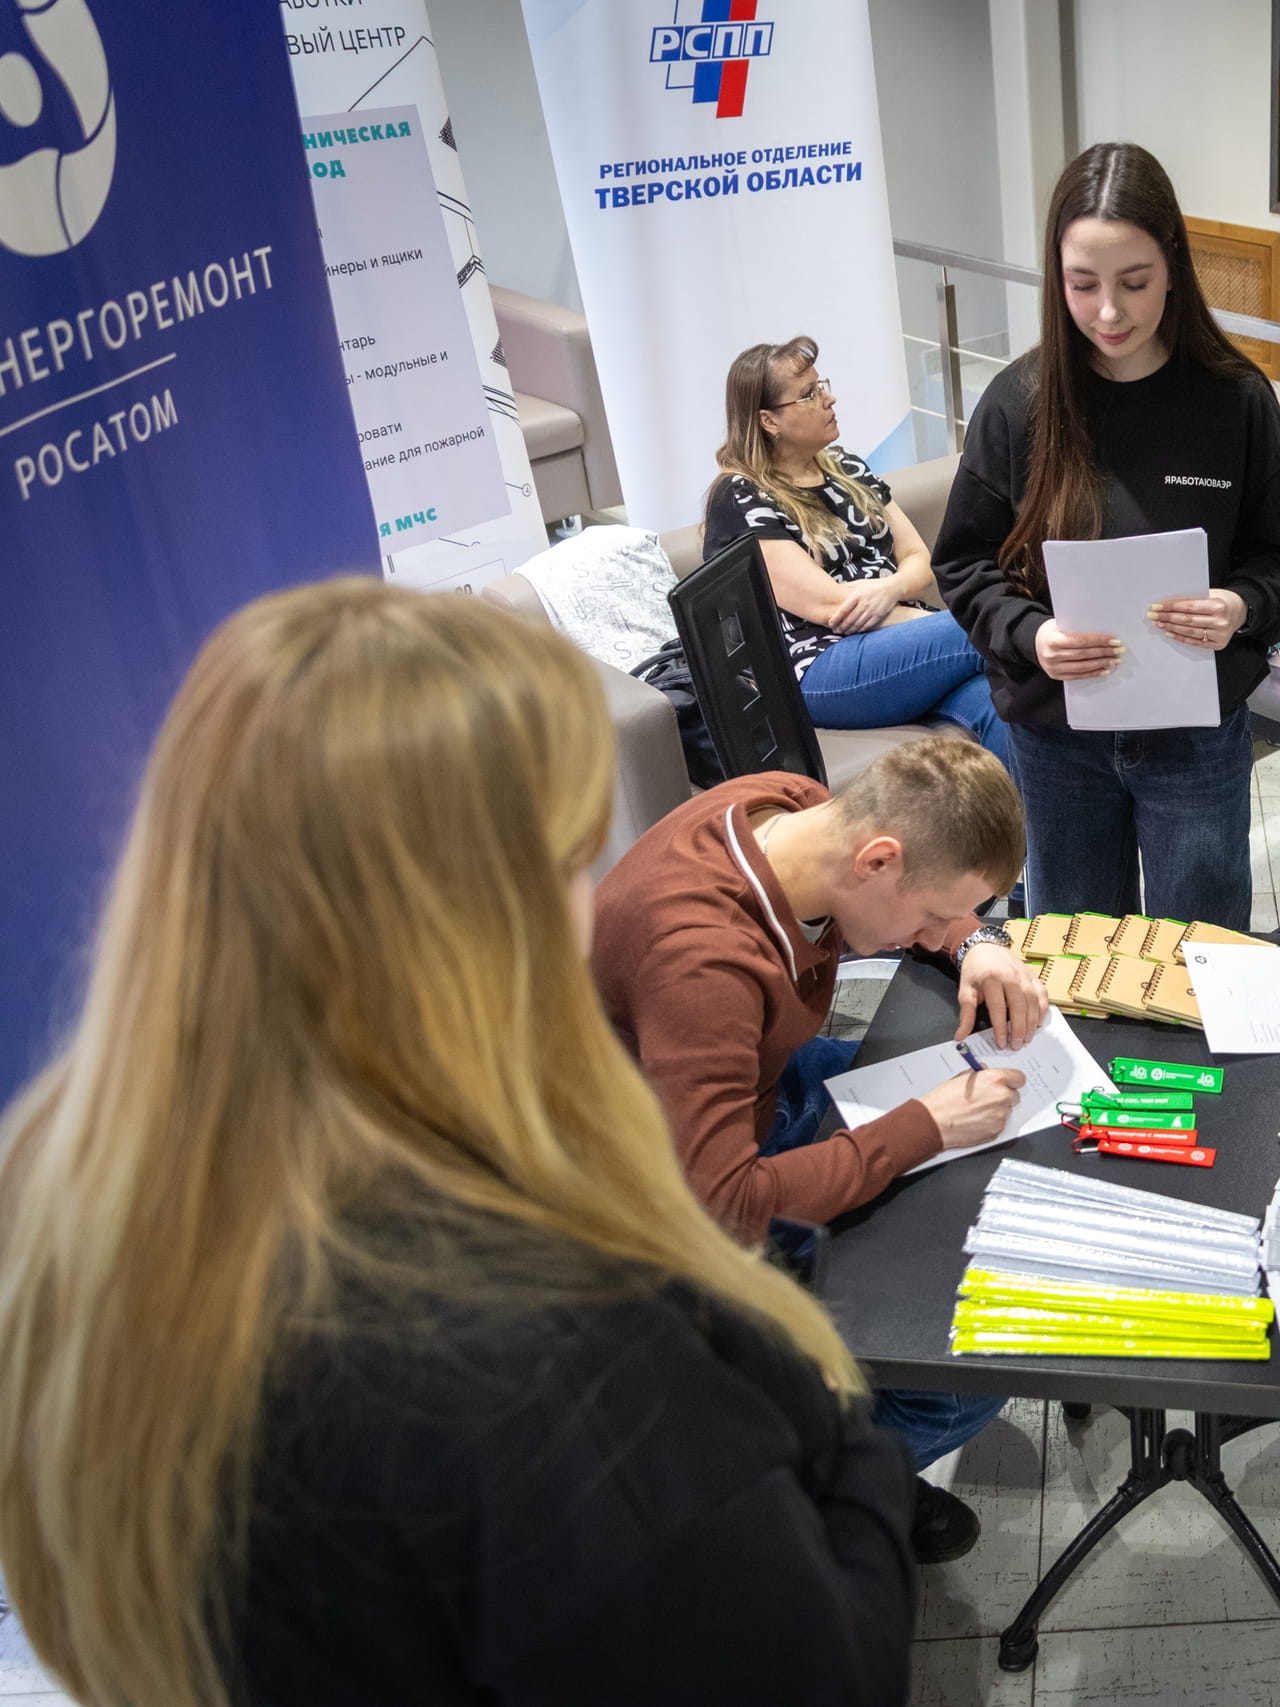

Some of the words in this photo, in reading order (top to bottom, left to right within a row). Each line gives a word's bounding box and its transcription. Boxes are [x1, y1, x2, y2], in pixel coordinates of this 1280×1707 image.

[338, 27, 406, 55] ЦЕНТР
[650, 23, 773, 62] РСПП
[303, 121, 411, 149] НИЧЕСКАЯ
[599, 151, 747, 180] РЕГИОНАЛЬНОЕ
[751, 141, 853, 165] ОТДЕЛЕНИЕ
[594, 169, 739, 210] ТВЕРСКОЙ
[746, 162, 863, 193] ОБЛАСТИ
[370, 257, 379, 269] и
[381, 249, 423, 266] ящики
[0, 245, 272, 398] НЕРГОРЕМОНТ
[365, 352, 437, 380] модульные
[440, 350, 448, 361] и
[14, 388, 179, 501] РОСАТОМ
[399, 446, 422, 463] для
[424, 426, 485, 454] пожарной
[1164, 475, 1232, 489] ЯРАБОТАЮВАЭР
[395, 507, 438, 532] МЧС
